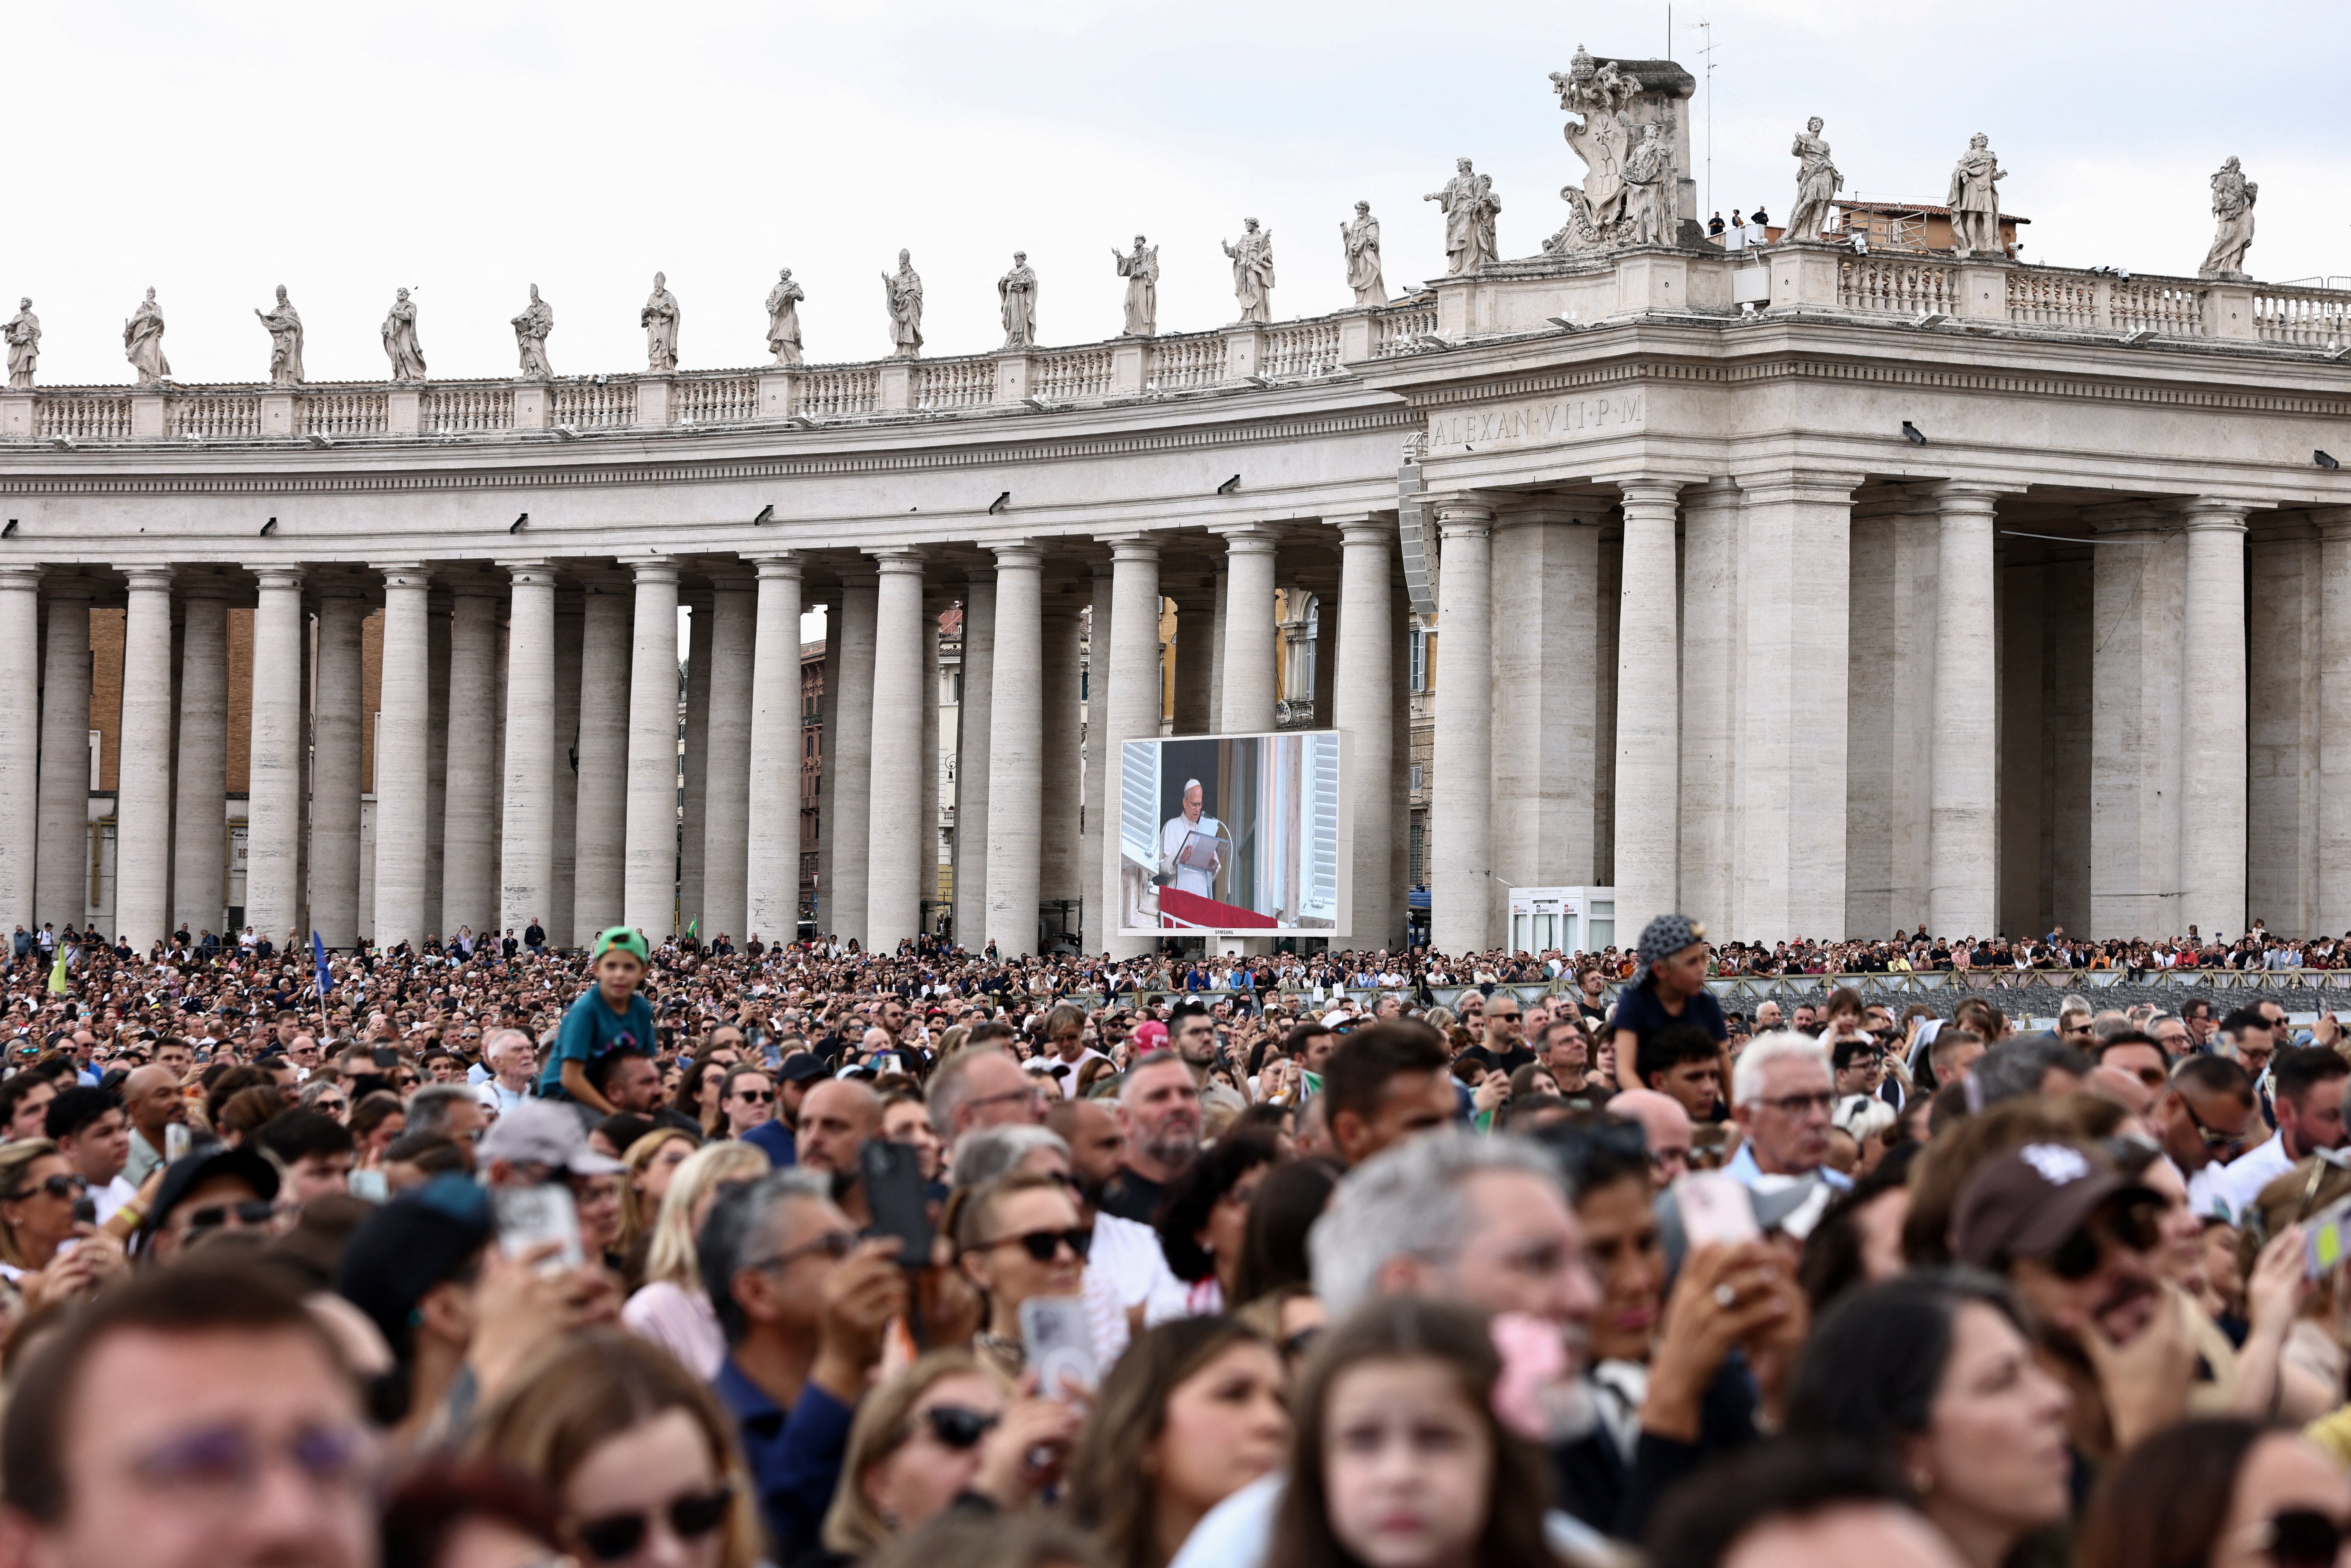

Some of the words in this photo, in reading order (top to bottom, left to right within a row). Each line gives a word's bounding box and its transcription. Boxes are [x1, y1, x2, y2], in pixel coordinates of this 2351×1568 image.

[1432, 409, 1530, 446] ALEXAN
[1541, 401, 1585, 432] VII
[1596, 398, 1609, 426] P
[1620, 394, 1642, 423] M
[238, 849, 248, 859] RE
